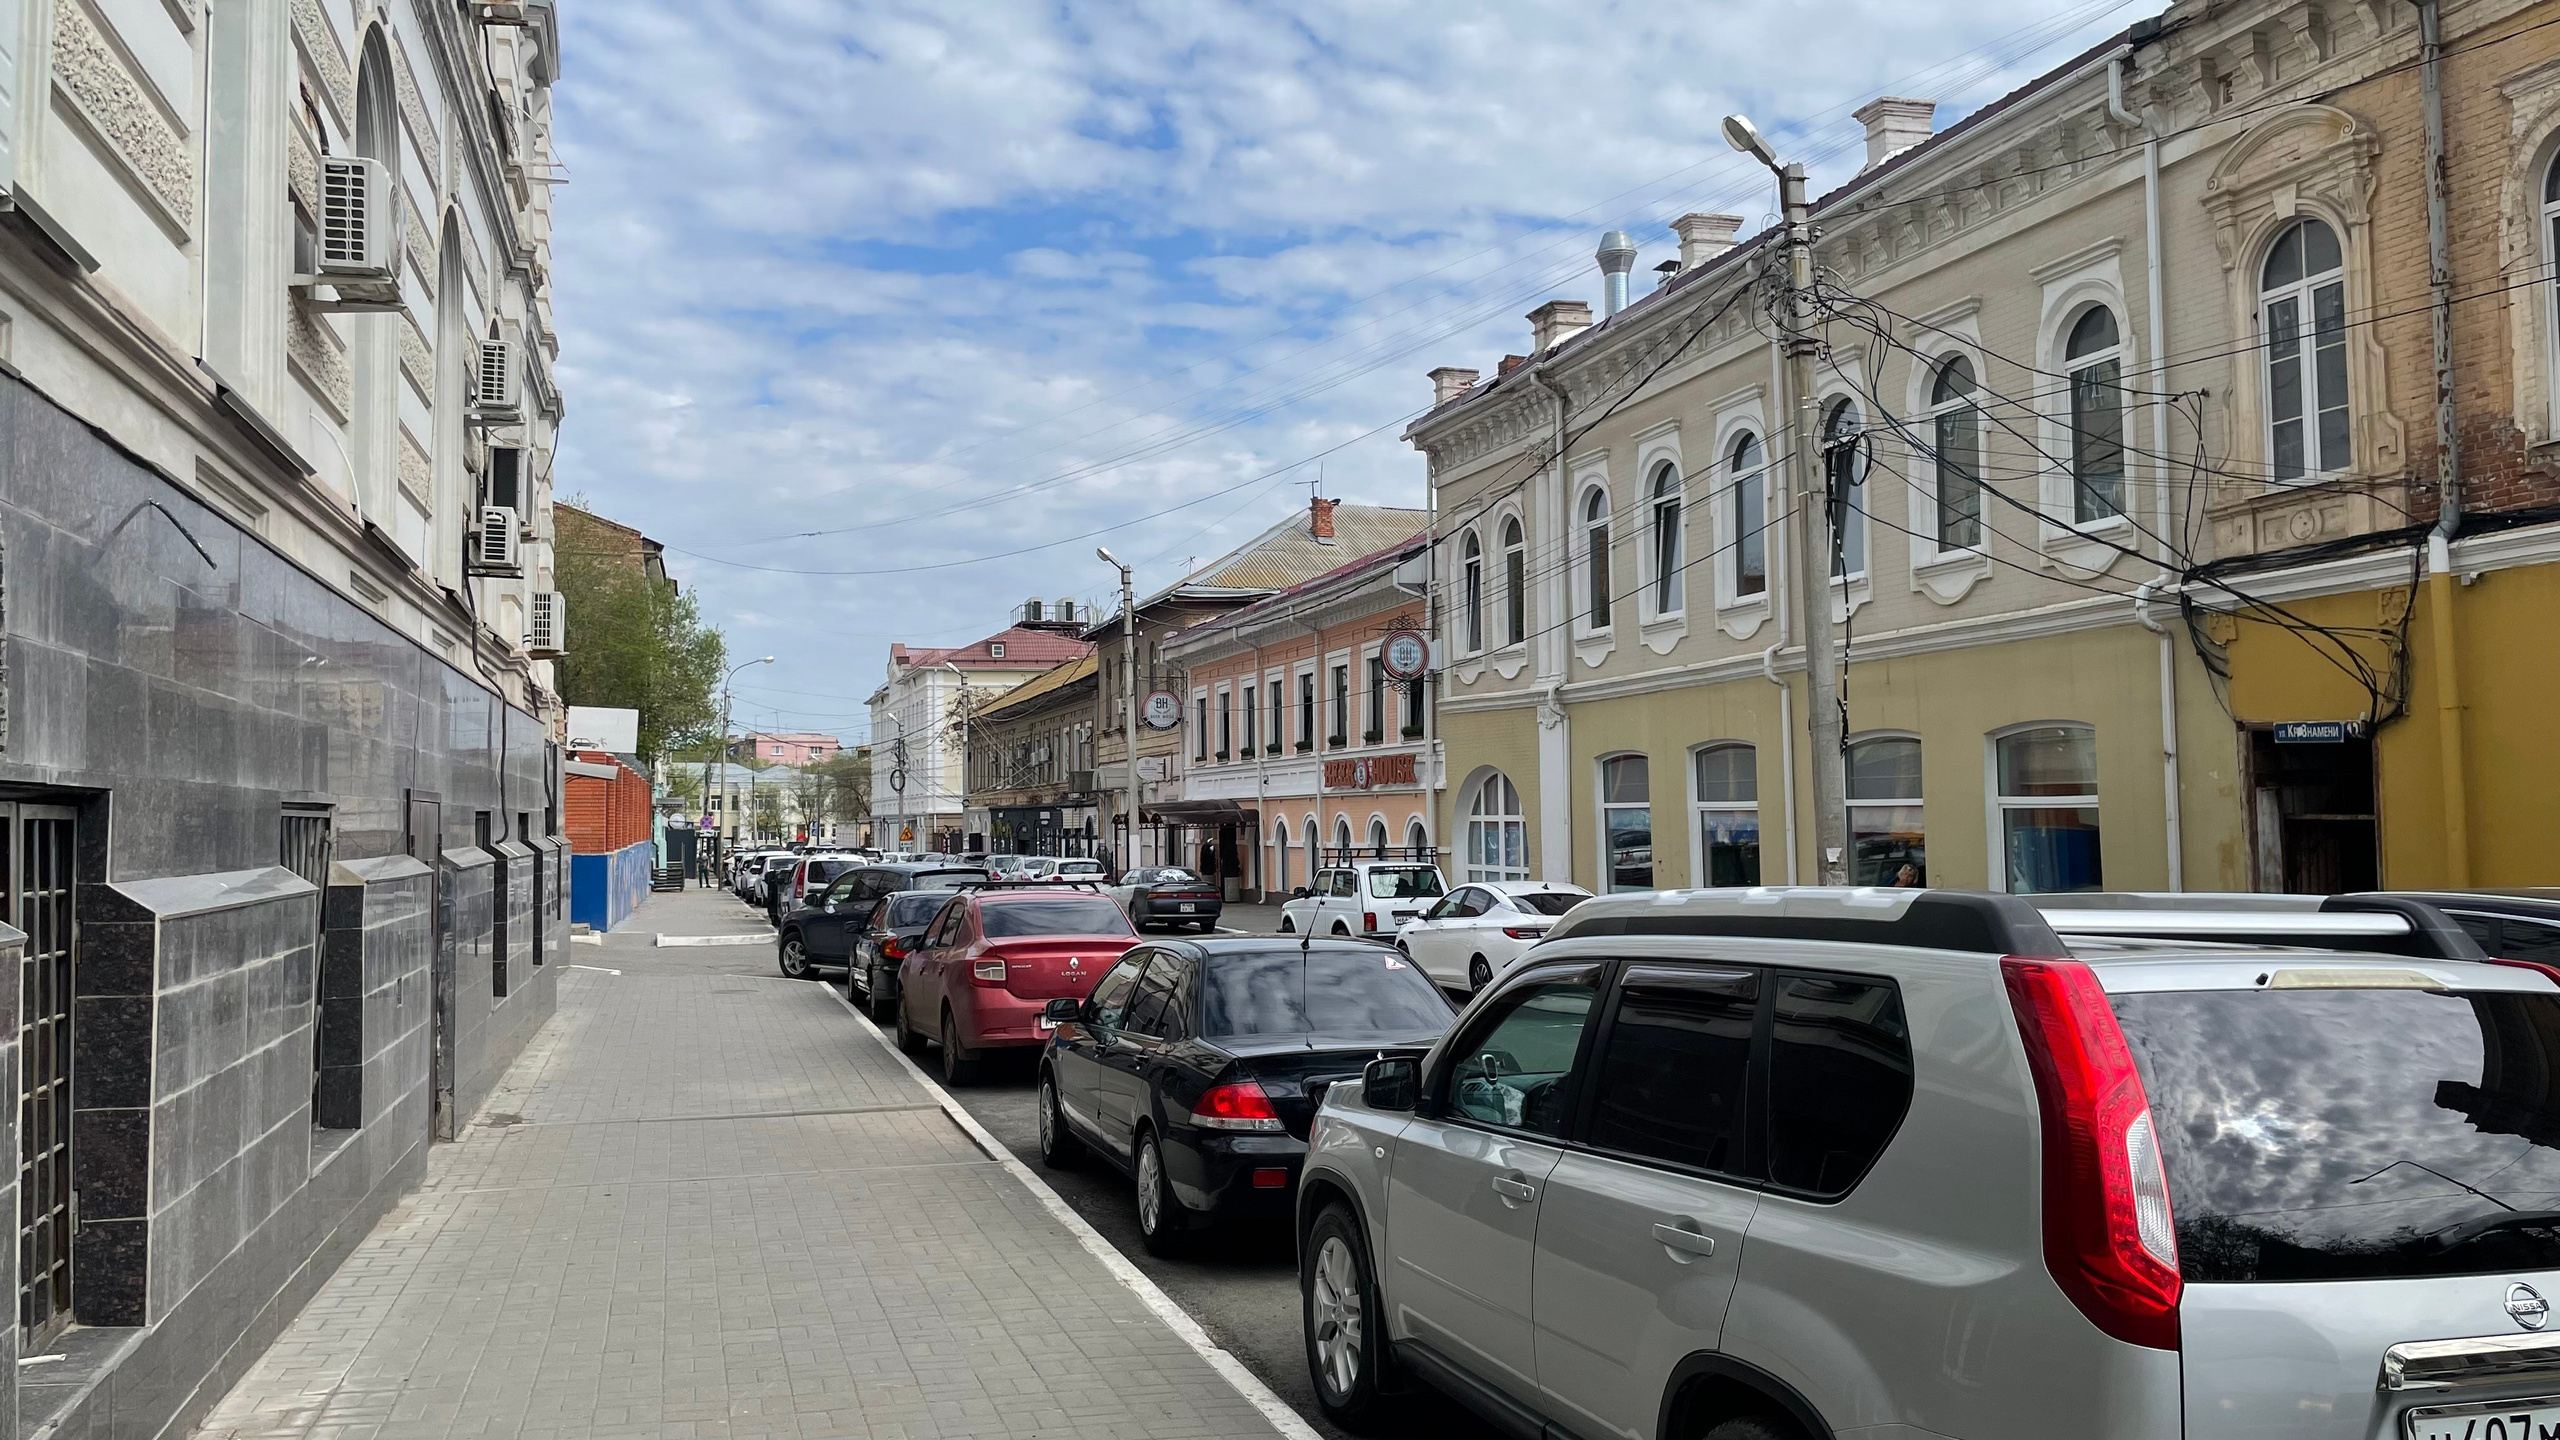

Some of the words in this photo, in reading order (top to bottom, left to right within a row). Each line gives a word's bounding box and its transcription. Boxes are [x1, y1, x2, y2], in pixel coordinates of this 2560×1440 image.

[1400, 647, 1412, 661] BH
[1156, 697, 1168, 709] BH
[1324, 759, 1356, 788] BEER
[1371, 753, 1417, 785] HOUSE
